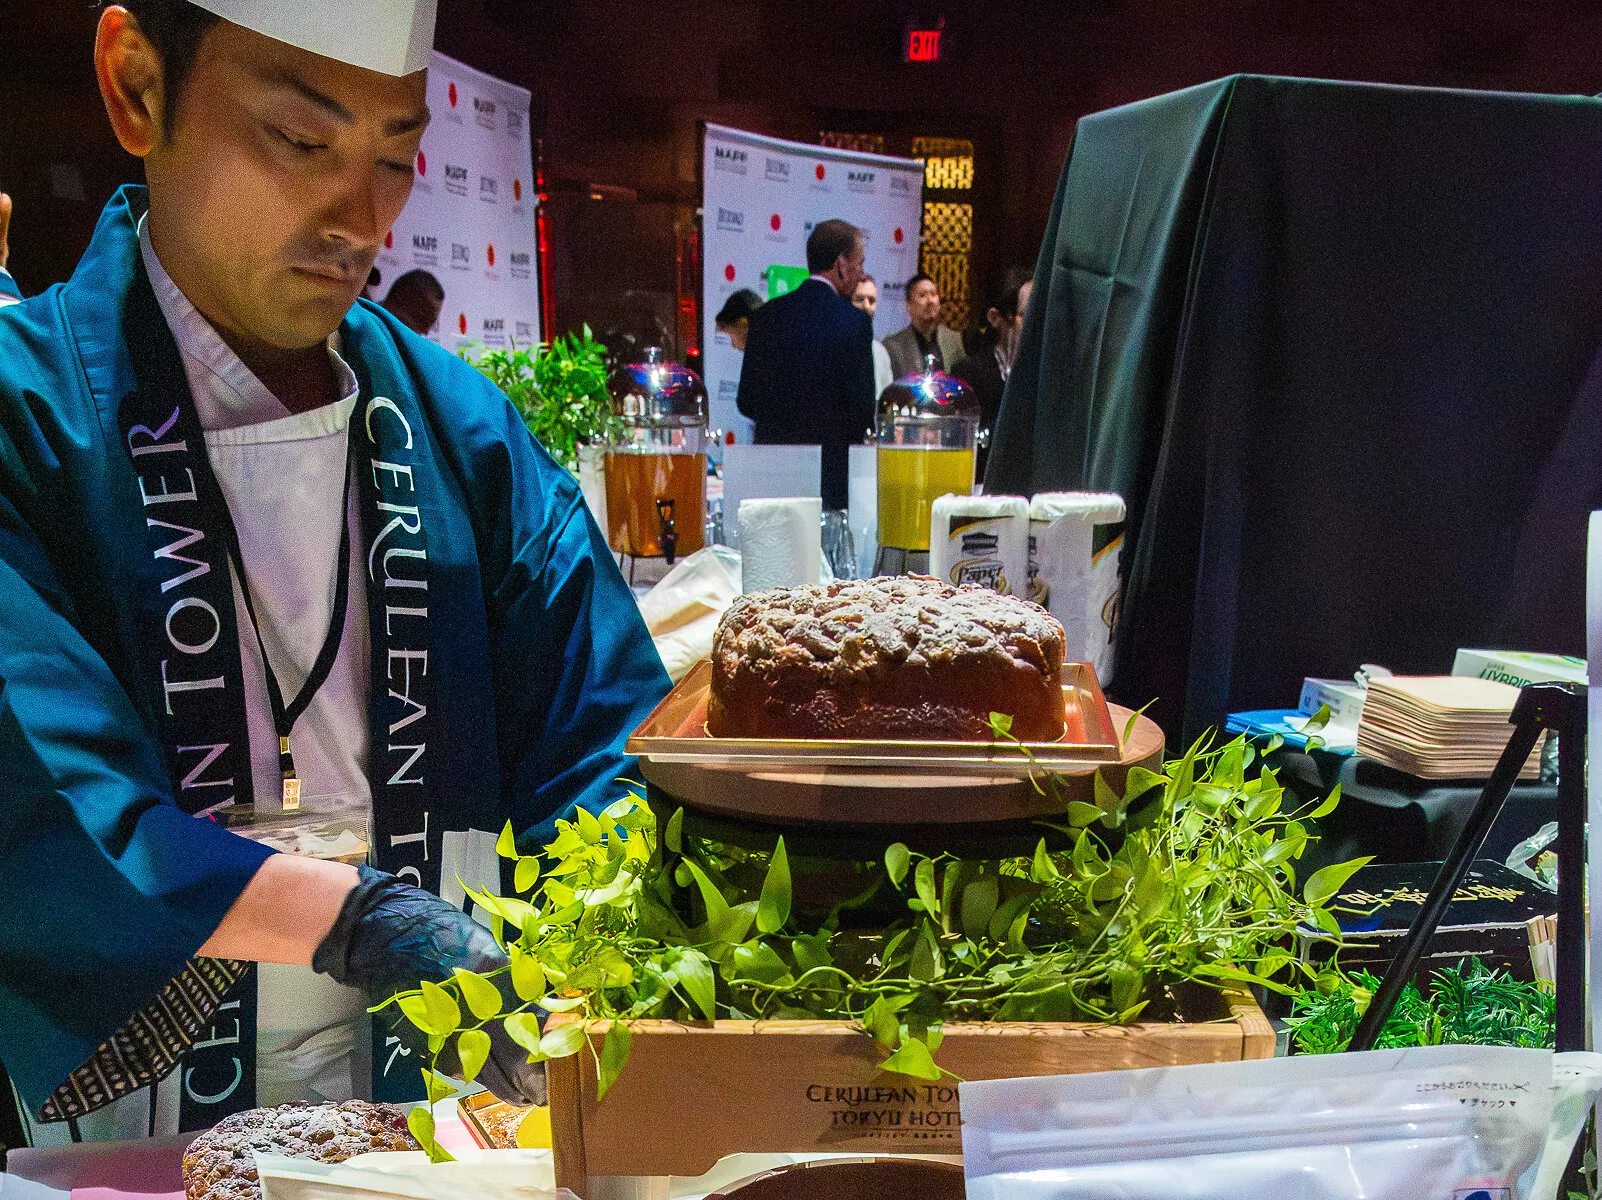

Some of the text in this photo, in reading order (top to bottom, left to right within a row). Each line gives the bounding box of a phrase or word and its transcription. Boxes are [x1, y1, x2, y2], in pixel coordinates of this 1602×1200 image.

[909, 31, 941, 61] EXIT
[127, 404, 225, 716] TOWER
[365, 395, 429, 786] CERULEAN
[806, 1083, 917, 1107] CERULEAN
